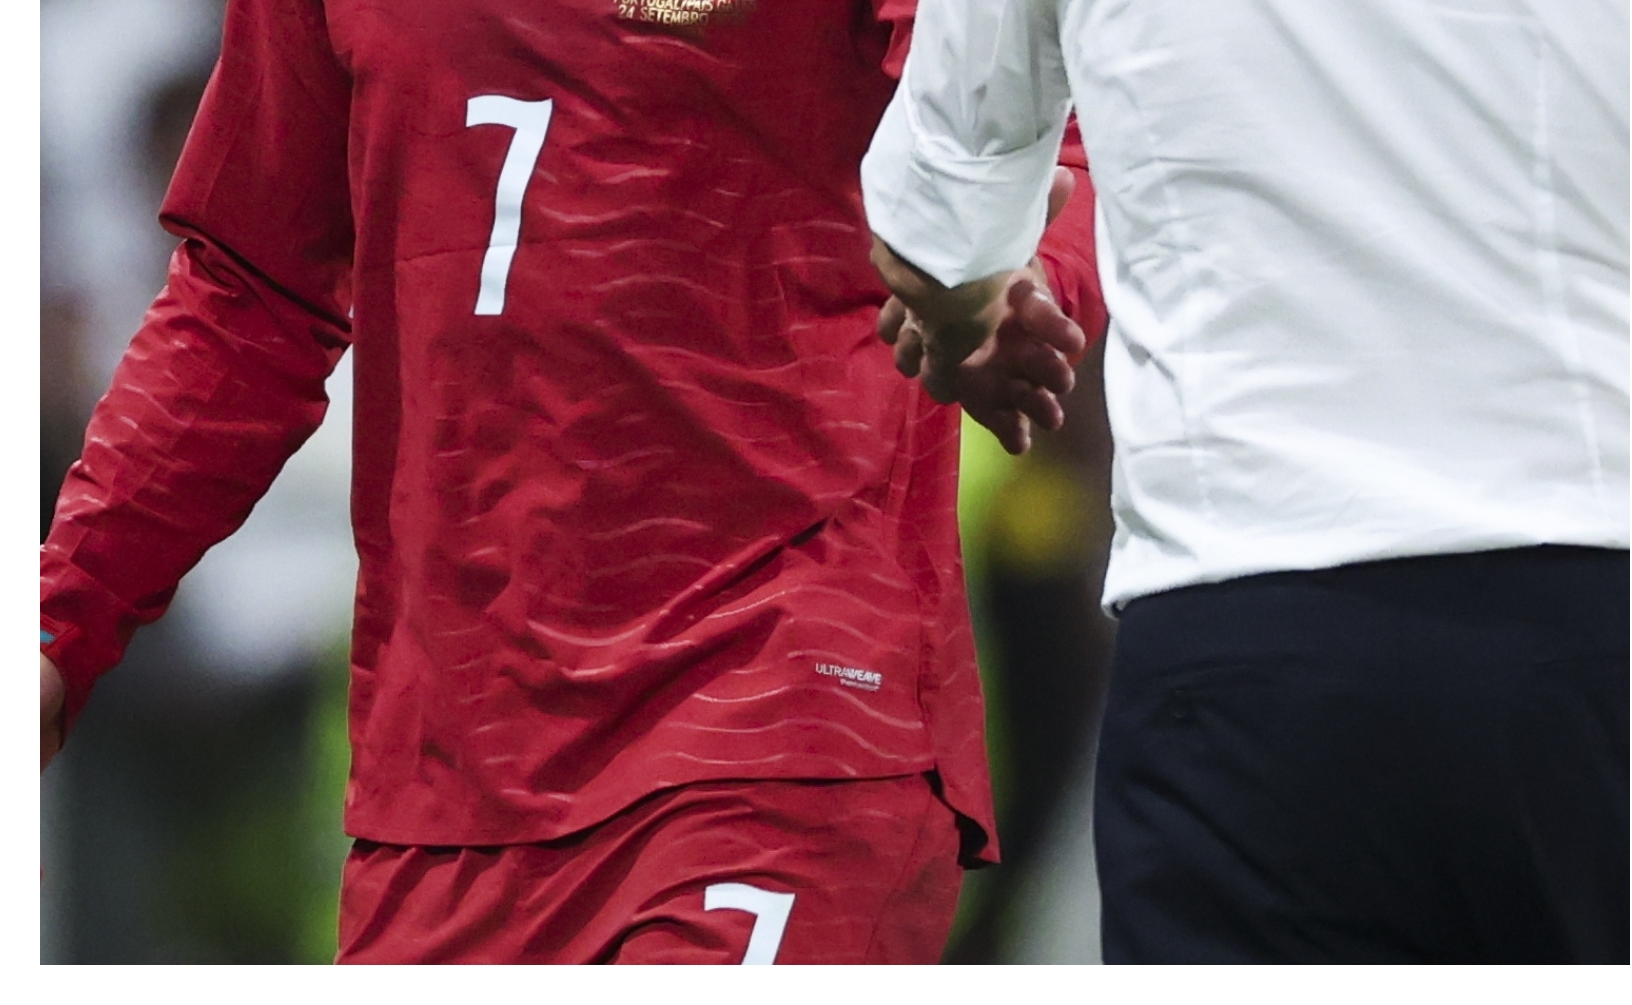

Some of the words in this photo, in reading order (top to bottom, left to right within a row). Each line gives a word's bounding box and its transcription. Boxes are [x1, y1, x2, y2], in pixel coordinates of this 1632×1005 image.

[618, 4, 634, 20] 24
[465, 94, 553, 316] 7
[815, 662, 883, 686] ULTRAWEAVE
